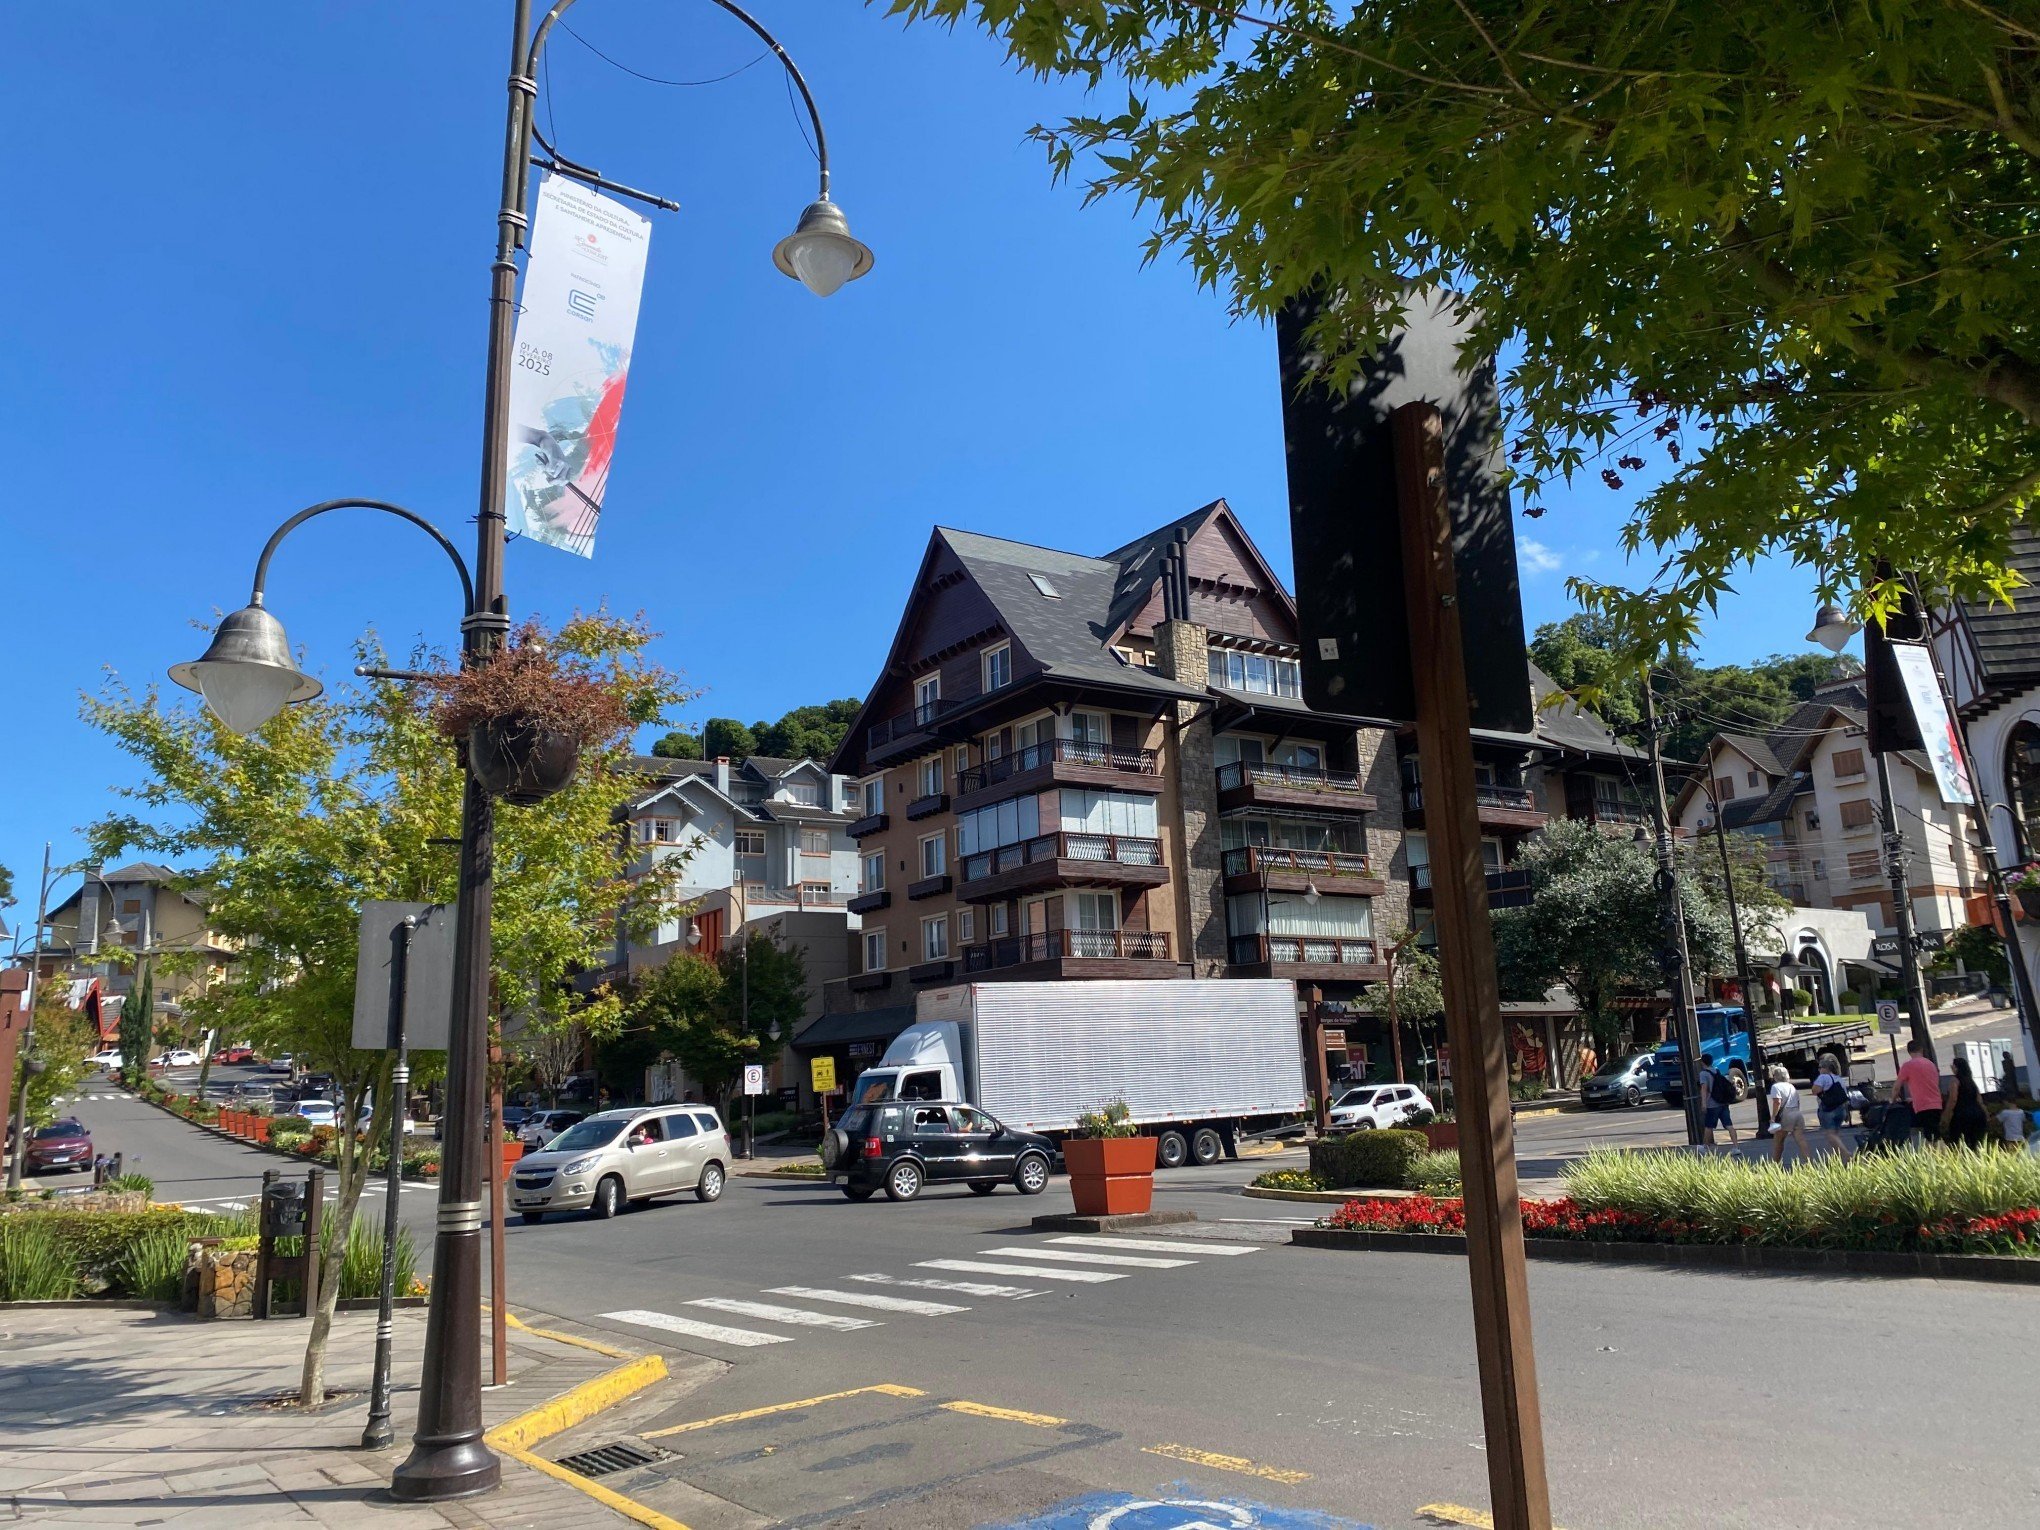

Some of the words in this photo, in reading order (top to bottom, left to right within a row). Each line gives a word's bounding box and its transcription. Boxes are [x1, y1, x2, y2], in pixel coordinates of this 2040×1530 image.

[543, 191, 577, 210] SECRETARIA
[578, 206, 586, 214] DE
[586, 210, 609, 225] ESTADO
[609, 220, 618, 229] DA
[618, 225, 644, 240] CULTURA
[593, 205, 602, 213] DA
[560, 207, 595, 225] SANTANDER
[596, 222, 632, 243] APRESENTAM
[520, 341, 530, 351] 01
[541, 350, 553, 360] 08
[518, 354, 550, 376] 2025
[1875, 942, 1898, 951] ROSA
[1350, 1060, 1366, 1079] 50
